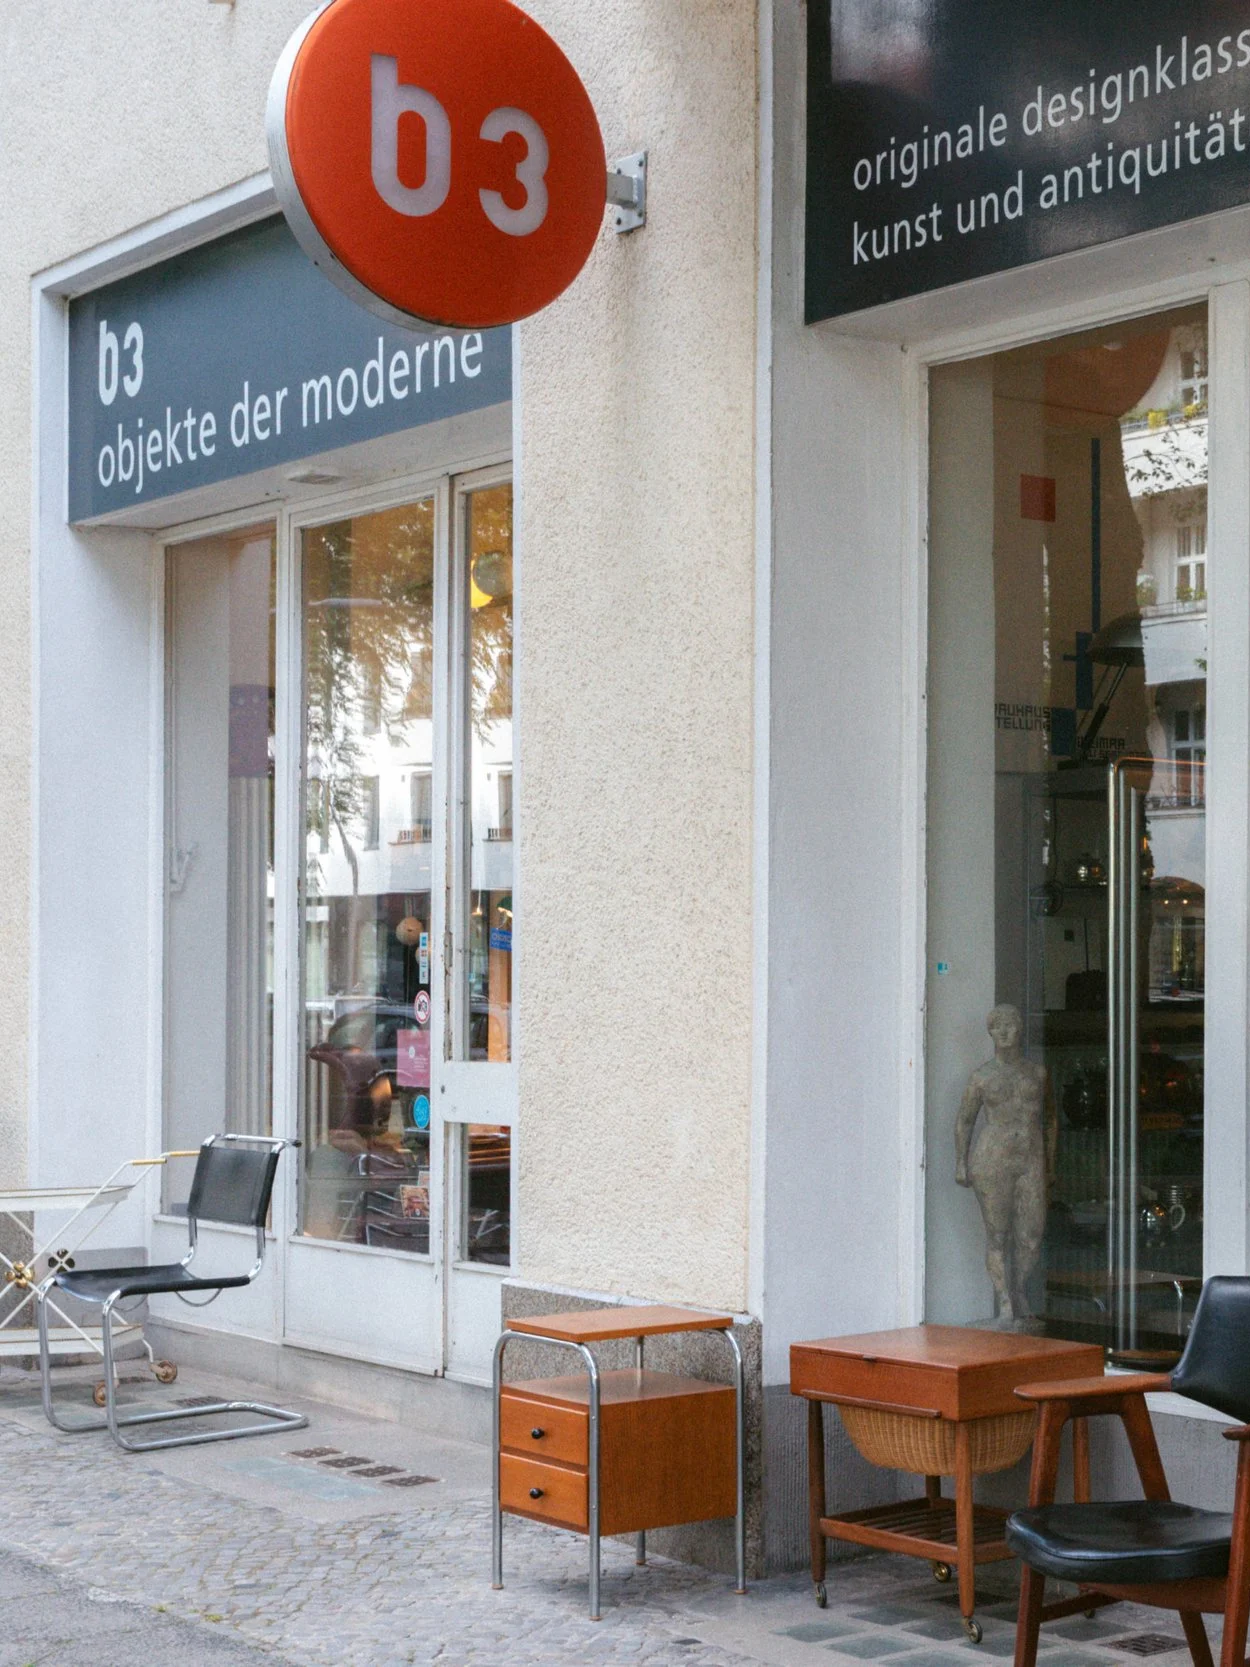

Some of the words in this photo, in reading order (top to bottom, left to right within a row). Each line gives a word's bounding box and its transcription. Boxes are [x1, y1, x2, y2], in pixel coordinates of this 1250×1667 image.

[371, 53, 550, 236] b3
[854, 105, 1008, 190] originale
[853, 202, 943, 265] kunst
[957, 170, 1023, 235] und
[98, 320, 144, 405] b3
[98, 406, 217, 494] objekte
[229, 381, 289, 448] der
[302, 333, 484, 428] moderne
